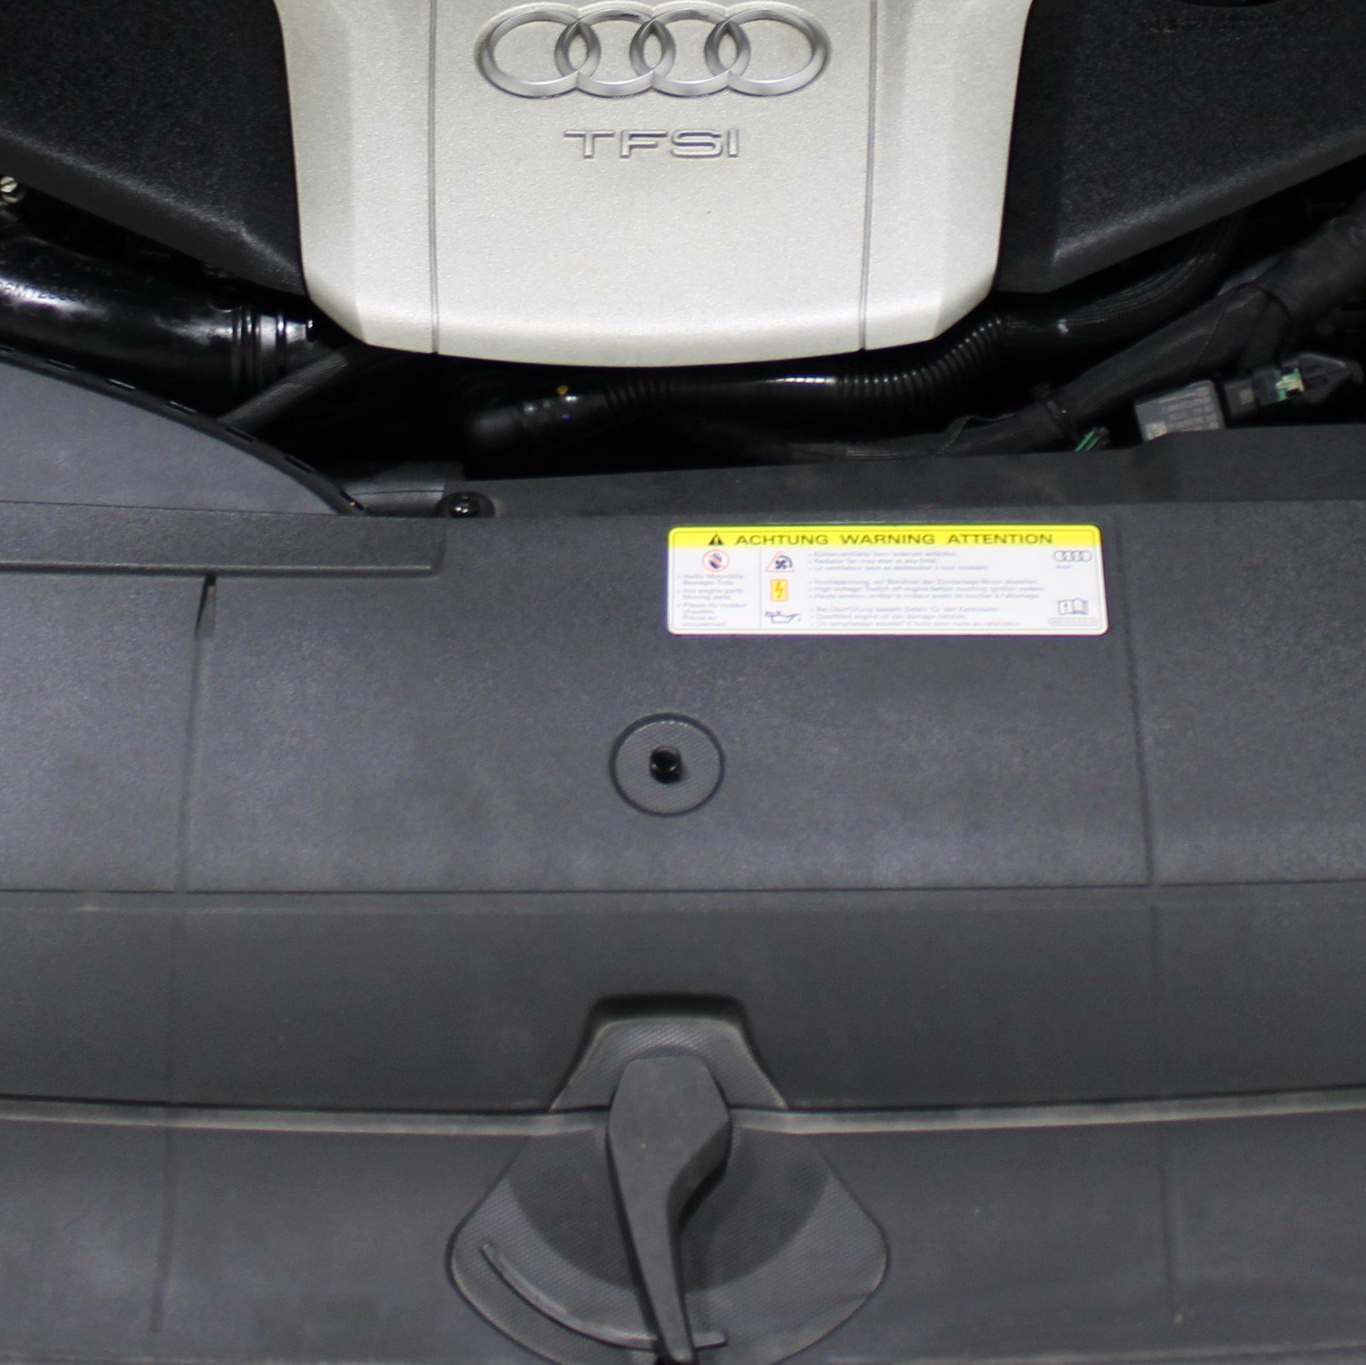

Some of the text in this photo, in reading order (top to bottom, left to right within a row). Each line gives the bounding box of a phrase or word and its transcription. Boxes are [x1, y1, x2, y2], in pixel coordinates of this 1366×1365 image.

[564, 128, 741, 159] TFSI
[735, 533, 1054, 546] ACHTUNG WARNING ATTENTION
